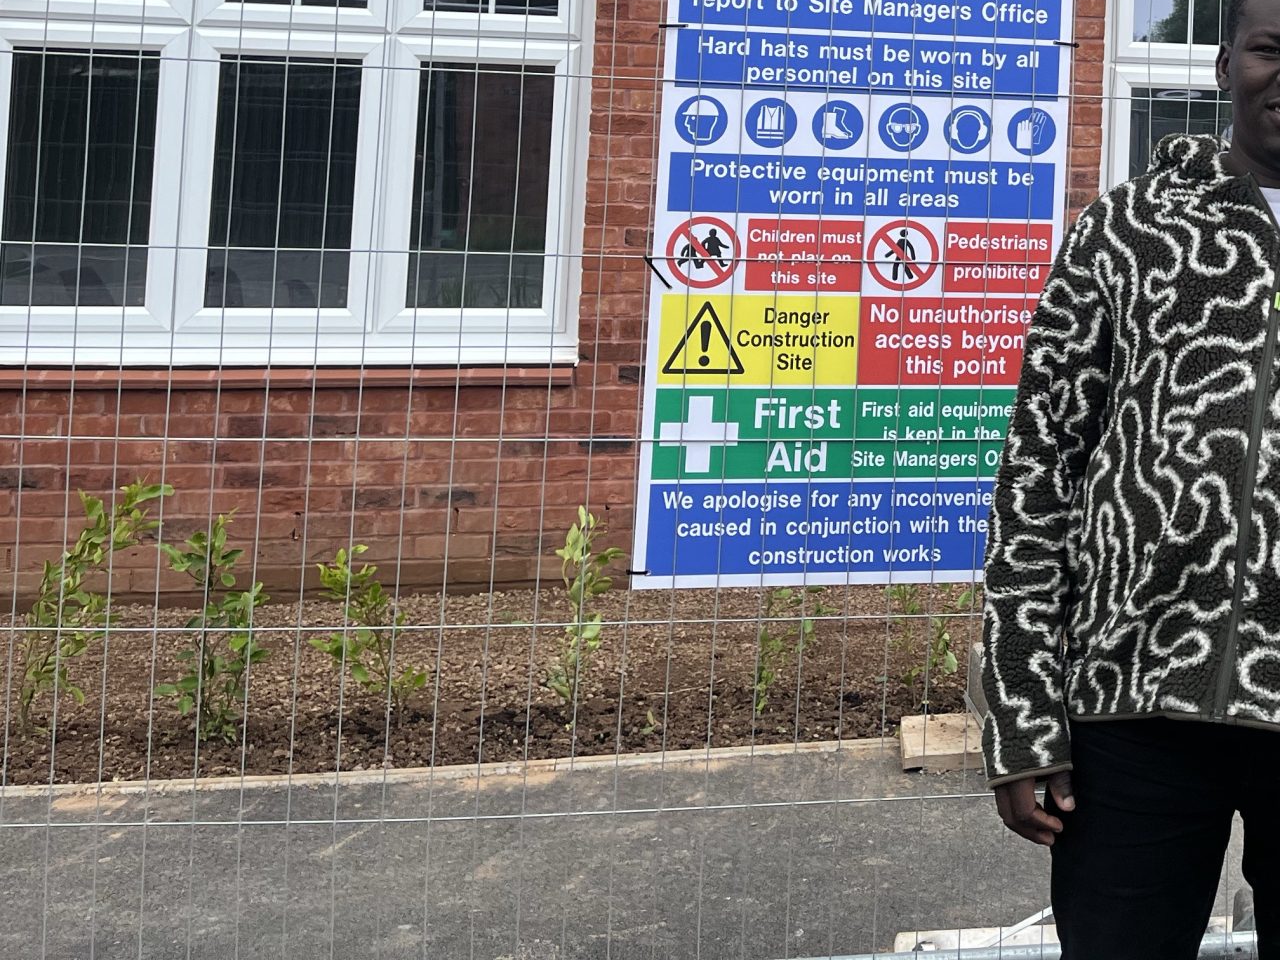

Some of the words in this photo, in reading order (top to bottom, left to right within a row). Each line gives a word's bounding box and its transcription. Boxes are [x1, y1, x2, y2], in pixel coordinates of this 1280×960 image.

[982, 1, 1048, 23] Office
[698, 37, 749, 55] Hard
[761, 40, 809, 59] hats
[819, 44, 872, 62] must
[883, 43, 910, 63] be
[920, 50, 971, 65] worn
[981, 47, 1006, 69] by
[1016, 50, 1039, 68] all
[747, 66, 857, 85] personnel
[868, 71, 894, 86] on
[904, 70, 942, 88] this
[953, 71, 991, 90] site
[690, 159, 806, 180] Protective
[817, 163, 934, 186] equipment
[944, 167, 997, 185] must
[1007, 165, 1035, 186] be
[769, 189, 822, 205] worn
[834, 187, 853, 205] in
[864, 188, 888, 206] all
[898, 192, 959, 208] areas
[750, 229, 815, 243] Children
[823, 231, 862, 244] must
[947, 233, 1048, 251] Pedestrians
[758, 251, 784, 263] not
[791, 251, 824, 266] play
[832, 254, 851, 264] on
[771, 271, 800, 284] this
[807, 271, 837, 285] site
[953, 264, 1040, 282] prohibited
[764, 307, 829, 328] Danger
[870, 304, 899, 323] No
[909, 304, 1036, 324] unauthorise
[737, 330, 855, 349] Construction
[875, 334, 952, 349] access
[961, 330, 1024, 352] beyon
[776, 353, 813, 371] Site
[906, 355, 943, 375] this
[953, 356, 1006, 378] point
[754, 398, 841, 430] First
[862, 401, 900, 418] First
[908, 402, 934, 418] aid
[941, 402, 1013, 420] equipme
[883, 426, 898, 440] is
[905, 426, 944, 445] kept
[952, 426, 966, 440] in
[974, 426, 1001, 440] the
[764, 441, 827, 472] Aid
[852, 450, 885, 467] Site
[893, 451, 977, 470] Managers
[663, 491, 693, 509] We
[702, 490, 801, 512] apologise
[811, 490, 839, 508] for
[848, 493, 882, 510] any
[891, 489, 993, 506] inconvenie
[677, 518, 751, 537] caused
[760, 517, 777, 535] in
[786, 517, 900, 538] conjunction
[909, 515, 949, 533] with
[958, 516, 989, 533] the
[748, 545, 873, 565] construction
[882, 544, 941, 563] works
